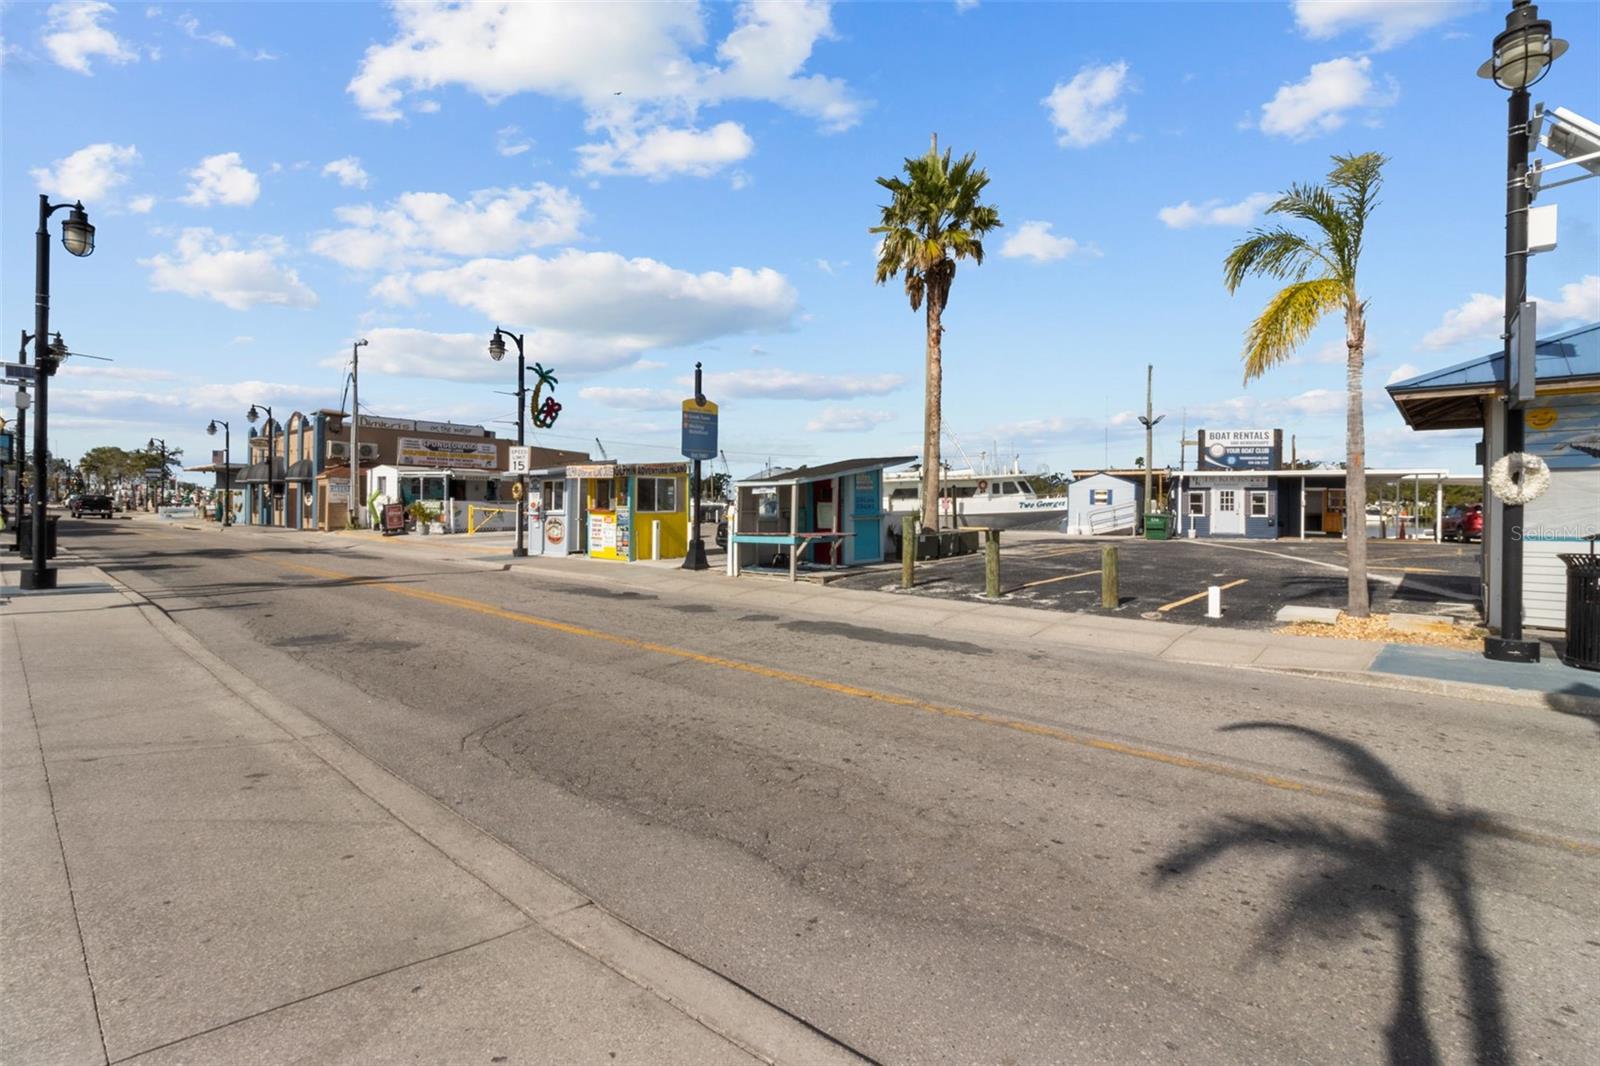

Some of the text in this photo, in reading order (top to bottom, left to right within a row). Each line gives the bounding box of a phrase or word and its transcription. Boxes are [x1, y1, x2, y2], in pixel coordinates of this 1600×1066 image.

[1209, 432, 1270, 440] BOAT RENTALS
[513, 461, 526, 471] 15
